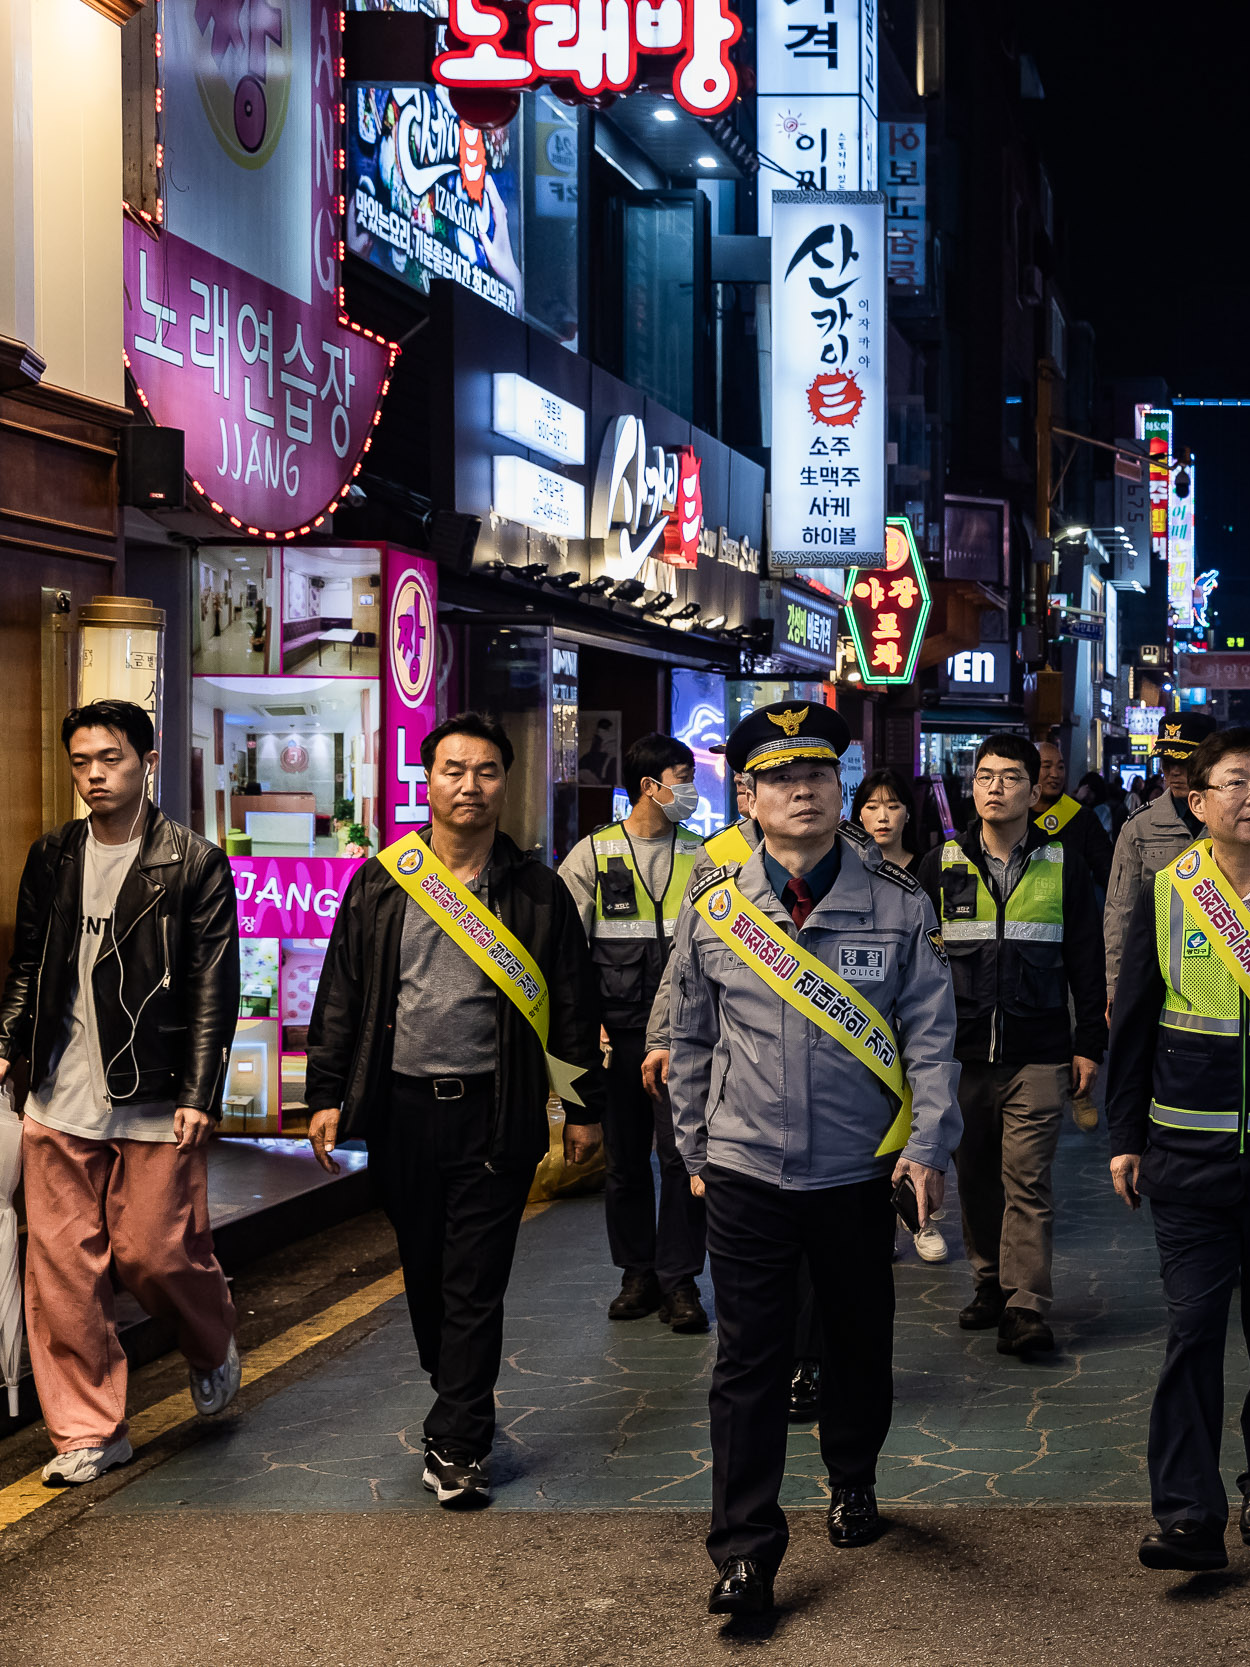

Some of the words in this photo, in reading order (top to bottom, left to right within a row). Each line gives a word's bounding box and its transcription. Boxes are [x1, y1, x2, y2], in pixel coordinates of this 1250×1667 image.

[432, 0, 742, 115] 노래방
[784, 0, 838, 70] 격
[435, 183, 479, 238] IZAKAYA
[784, 224, 860, 367] 산카이
[134, 251, 356, 459] 노래연습장
[857, 299, 871, 368] 이자카야
[217, 418, 300, 497] JJANG
[800, 466, 860, 487] 生맥주
[808, 436, 851, 457] 소주
[802, 526, 856, 546] 하이볼
[808, 497, 850, 517] 사케
[854, 576, 918, 609] 야장
[872, 613, 902, 673] 포차
[420, 873, 467, 919] 안전하고
[457, 912, 496, 949] 건전한
[487, 942, 525, 980] 청년의
[515, 972, 541, 1001] 거리
[1191, 878, 1248, 948] 안전하고
[729, 912, 800, 981] 범죄없는
[793, 969, 871, 1038] 건대맛의
[864, 1026, 897, 1068] 거리
[843, 968, 880, 977] POLICE
[844, 949, 880, 967] 경찰
